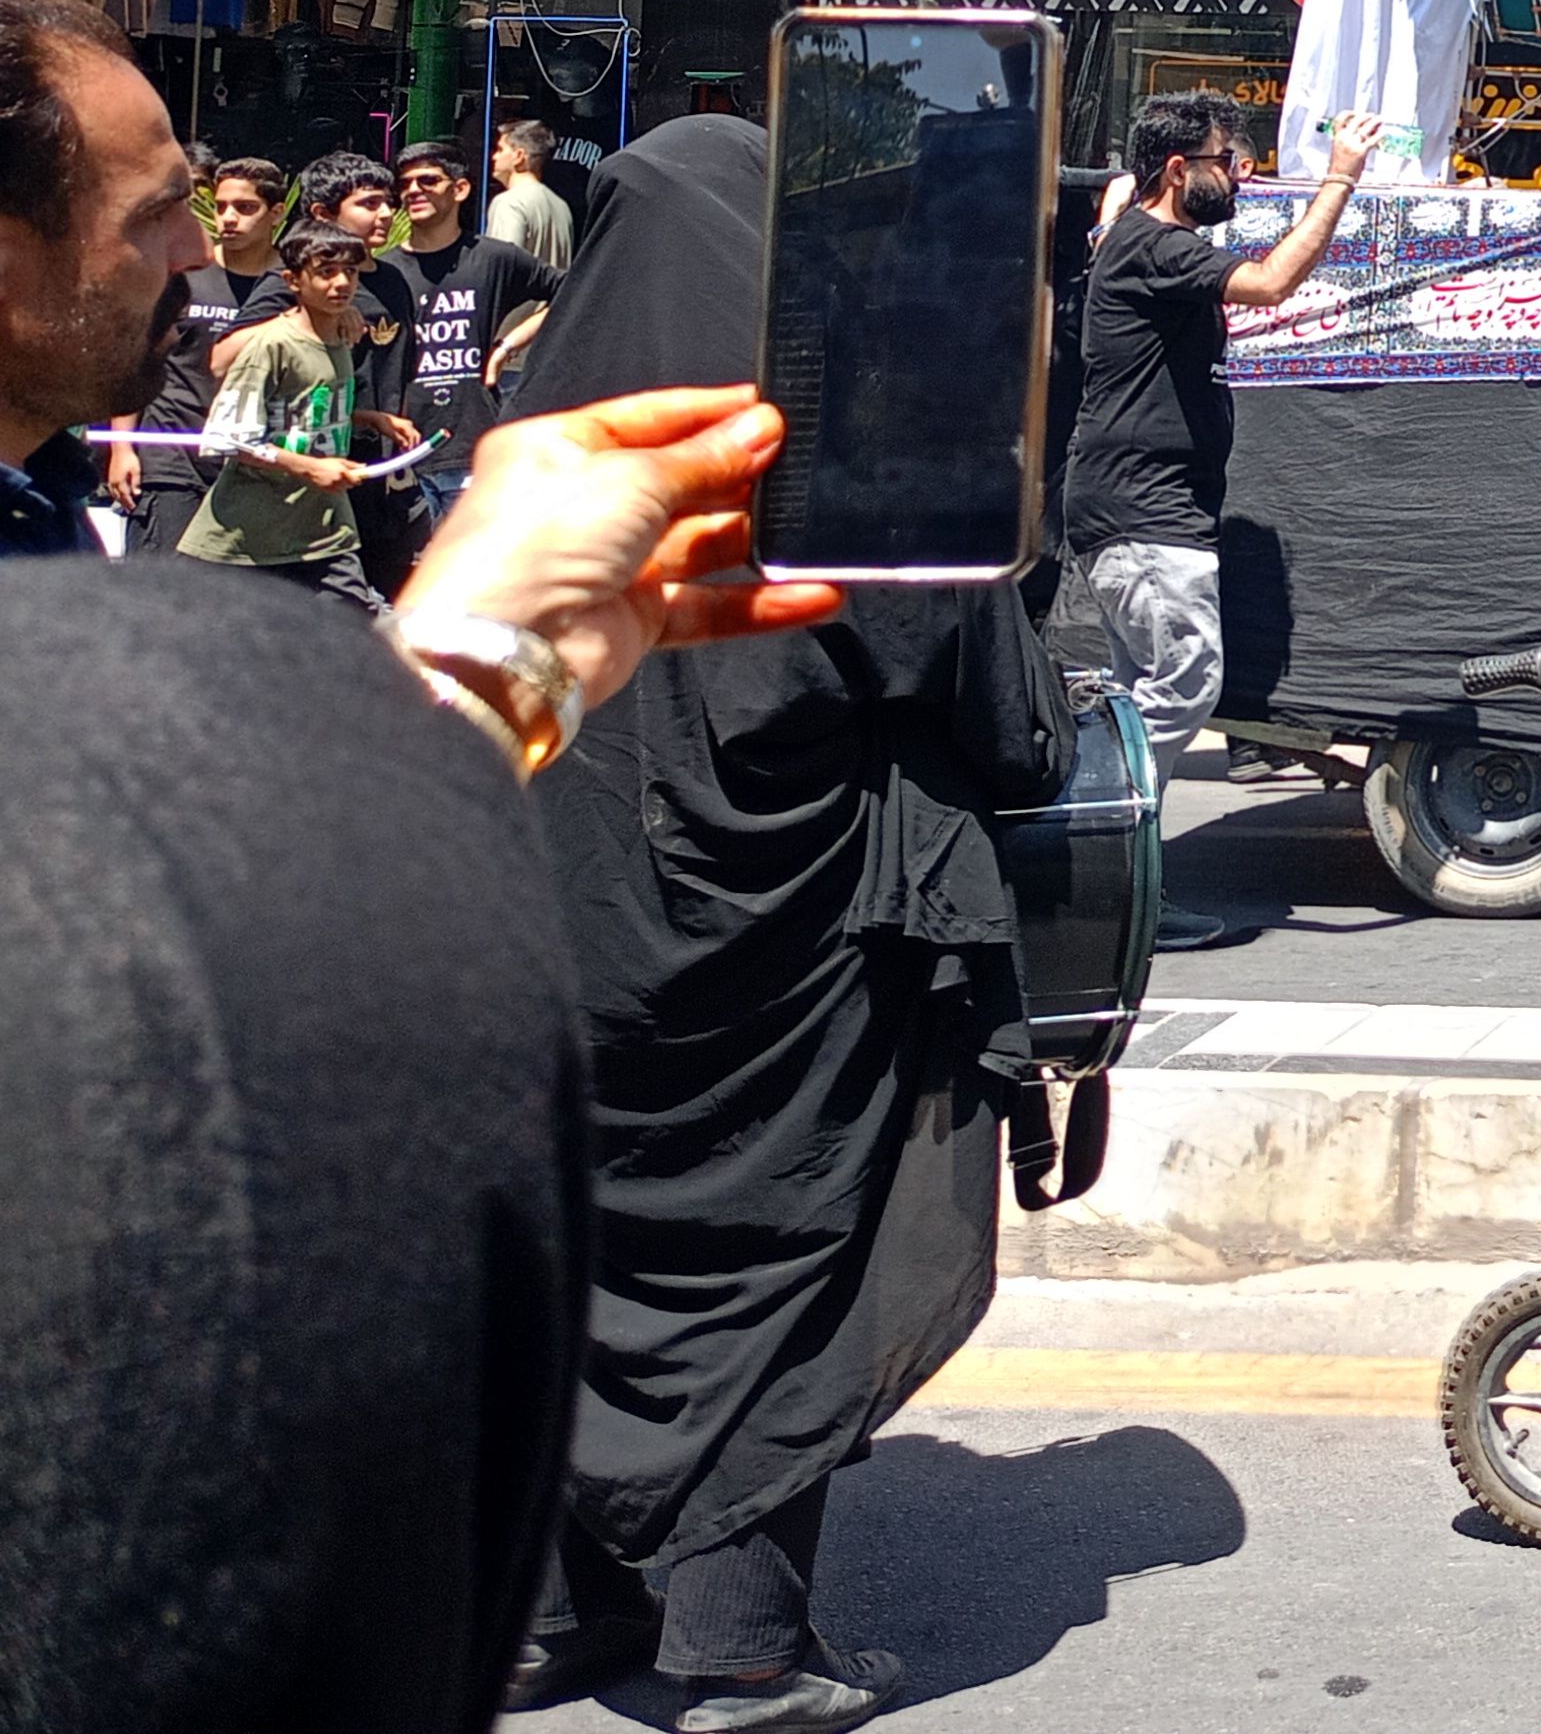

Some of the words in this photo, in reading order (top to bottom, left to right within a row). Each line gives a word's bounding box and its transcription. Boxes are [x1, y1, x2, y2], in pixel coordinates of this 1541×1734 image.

[431, 290, 476, 314] AM
[415, 319, 471, 341] NOT
[417, 348, 481, 373] ASIC
